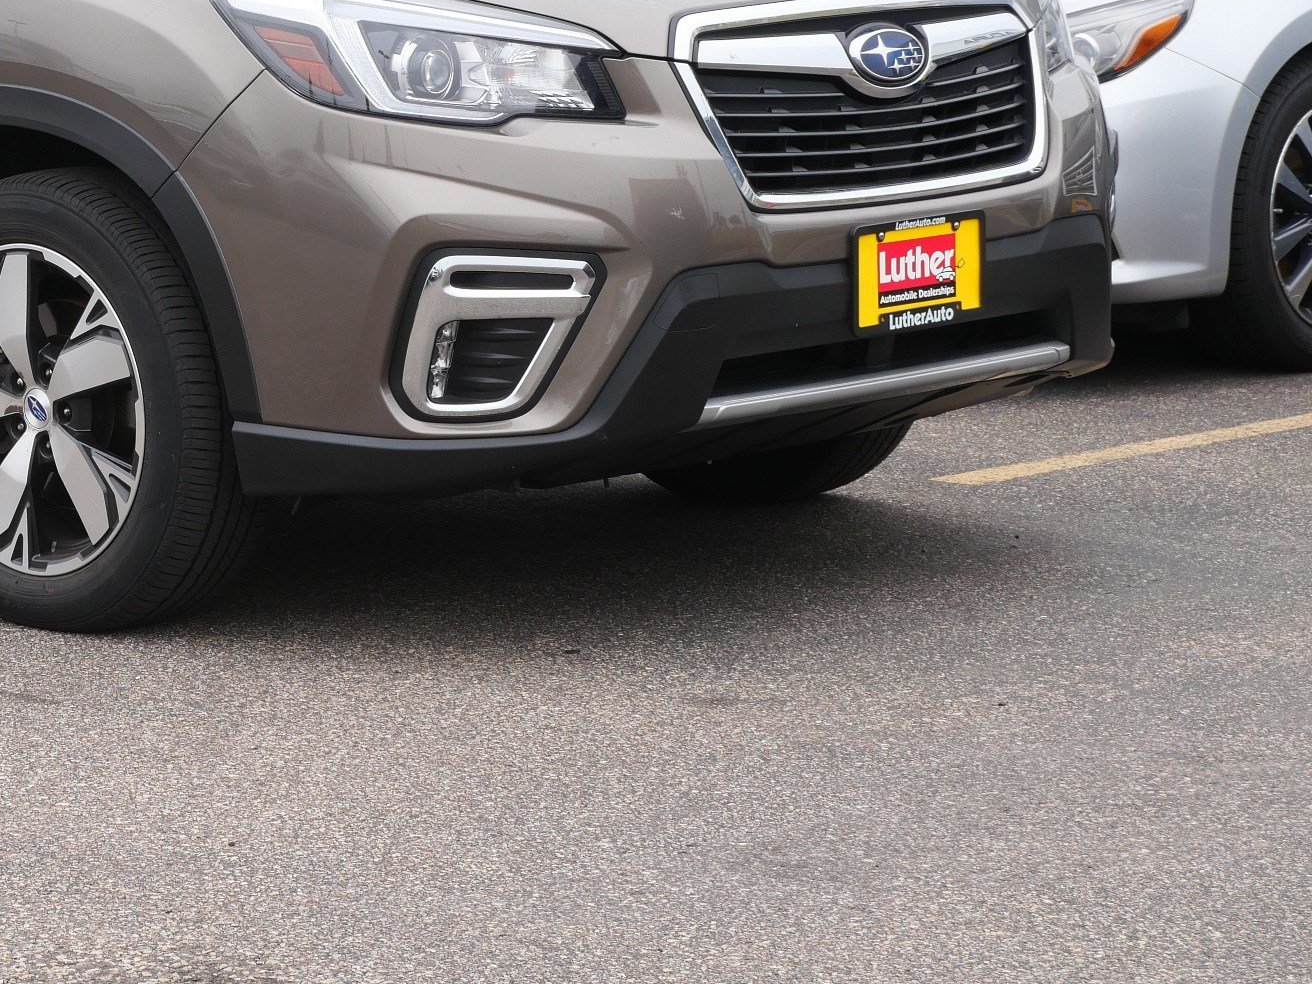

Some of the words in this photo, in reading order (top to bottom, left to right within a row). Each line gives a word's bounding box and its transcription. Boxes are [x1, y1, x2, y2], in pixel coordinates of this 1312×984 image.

[895, 217, 946, 230] LutherAuto.com
[879, 246, 955, 284] Luther
[879, 290, 918, 305] Automobile
[918, 285, 955, 299] Dealerships
[889, 306, 955, 330] LutherAuto
